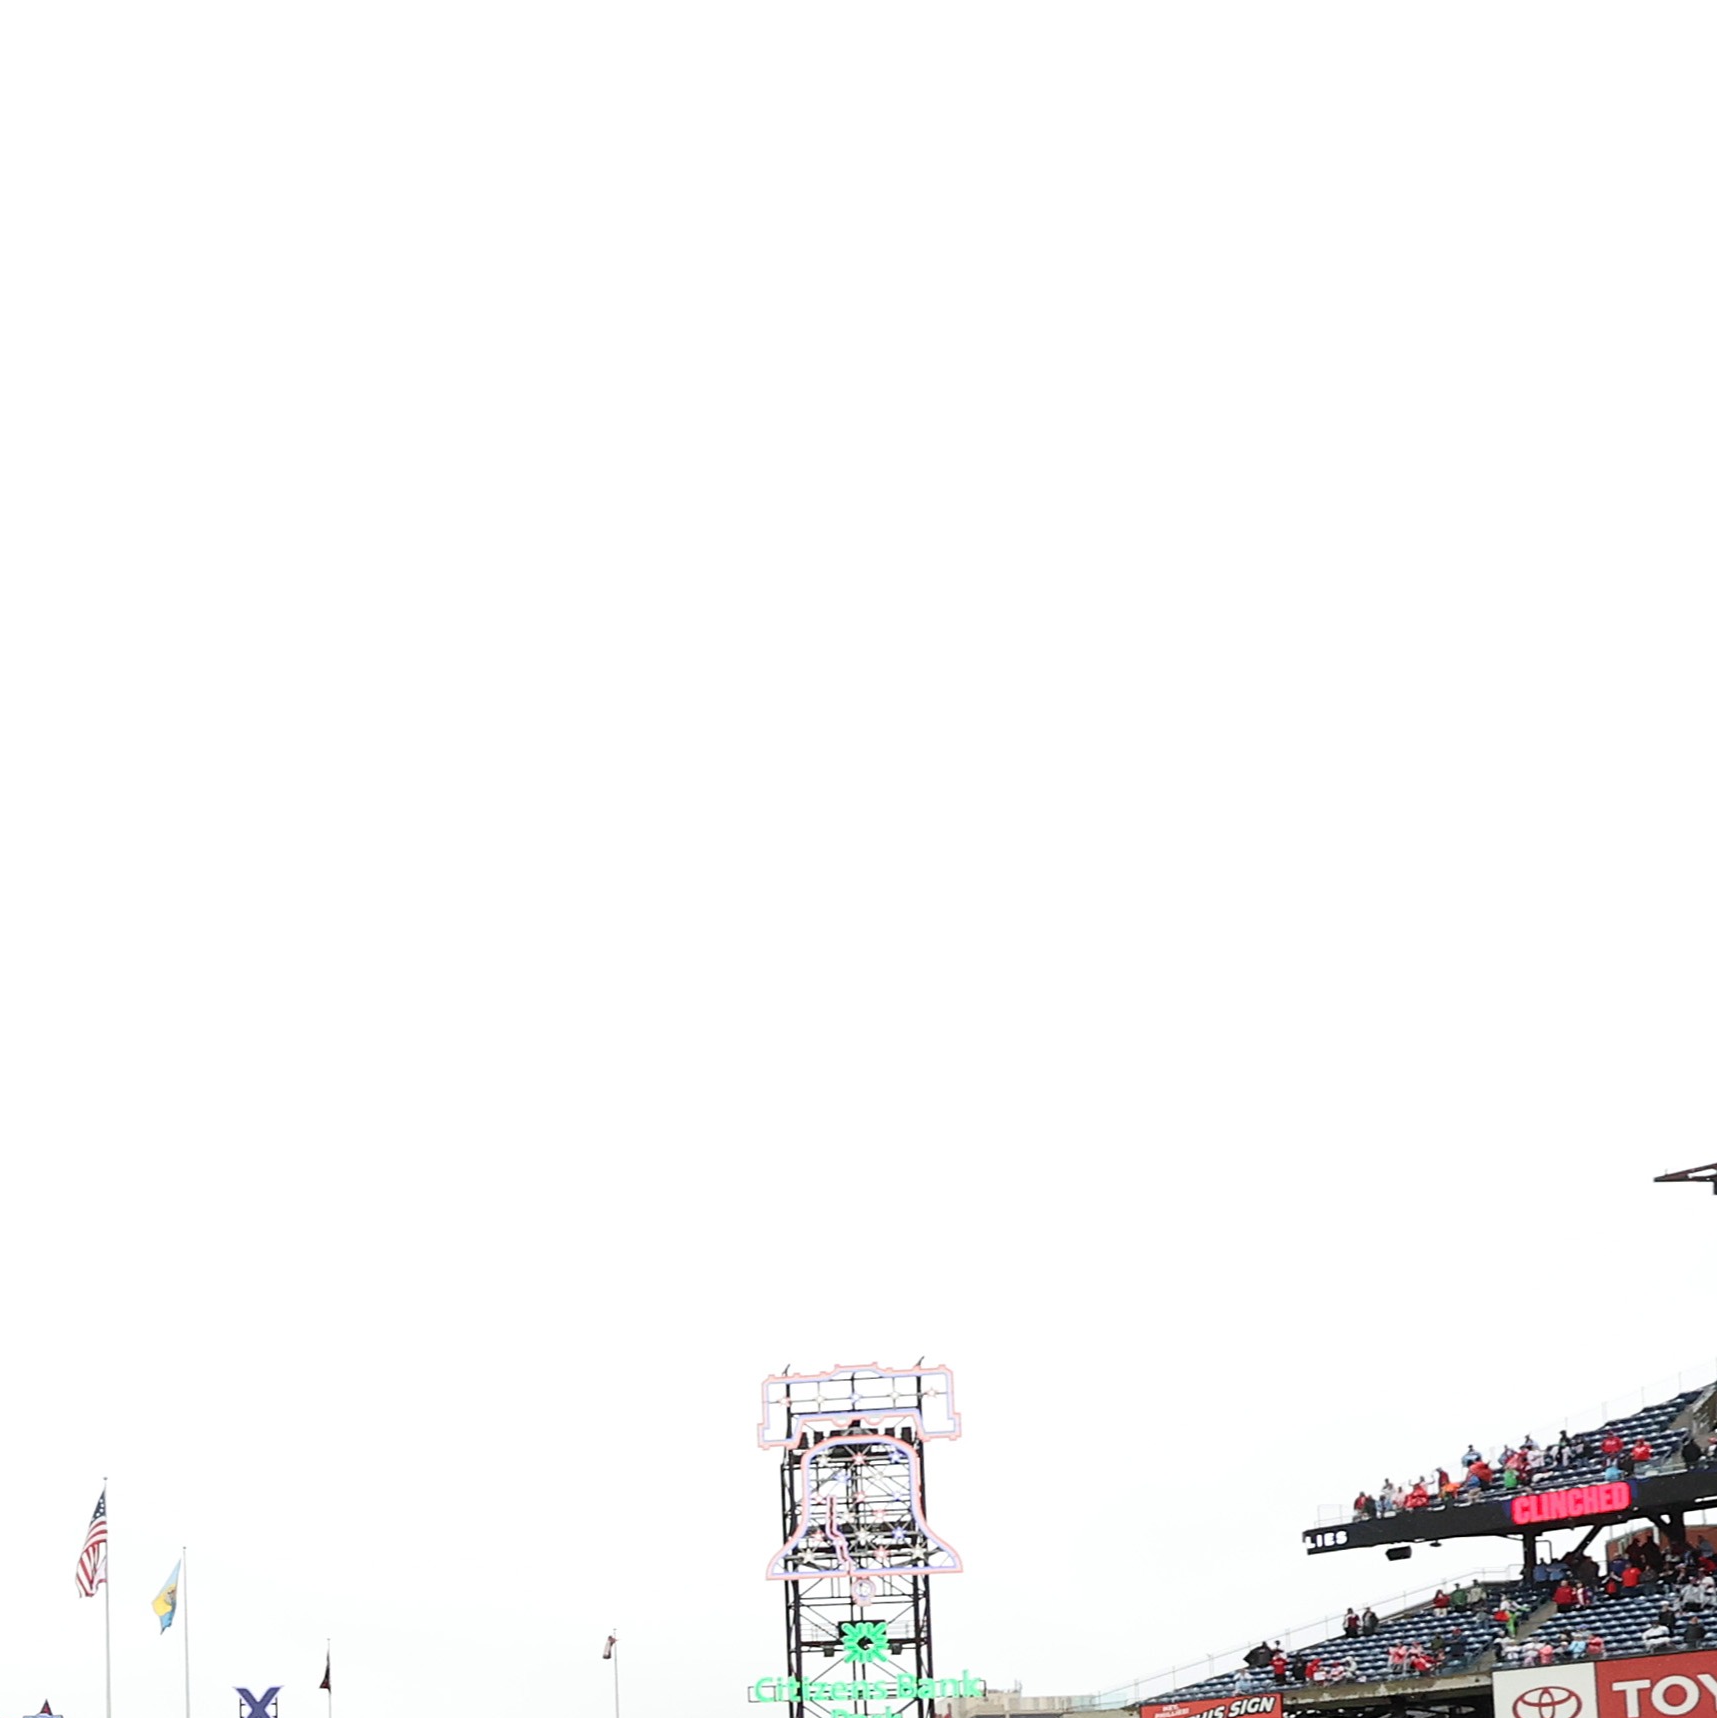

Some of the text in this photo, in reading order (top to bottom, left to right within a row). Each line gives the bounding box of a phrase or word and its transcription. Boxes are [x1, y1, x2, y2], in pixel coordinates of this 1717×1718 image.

[1512, 1484, 1630, 1522] CLINCHED
[754, 1669, 983, 1703] Citizens Bank
[1228, 1697, 1275, 1717] SIGN
